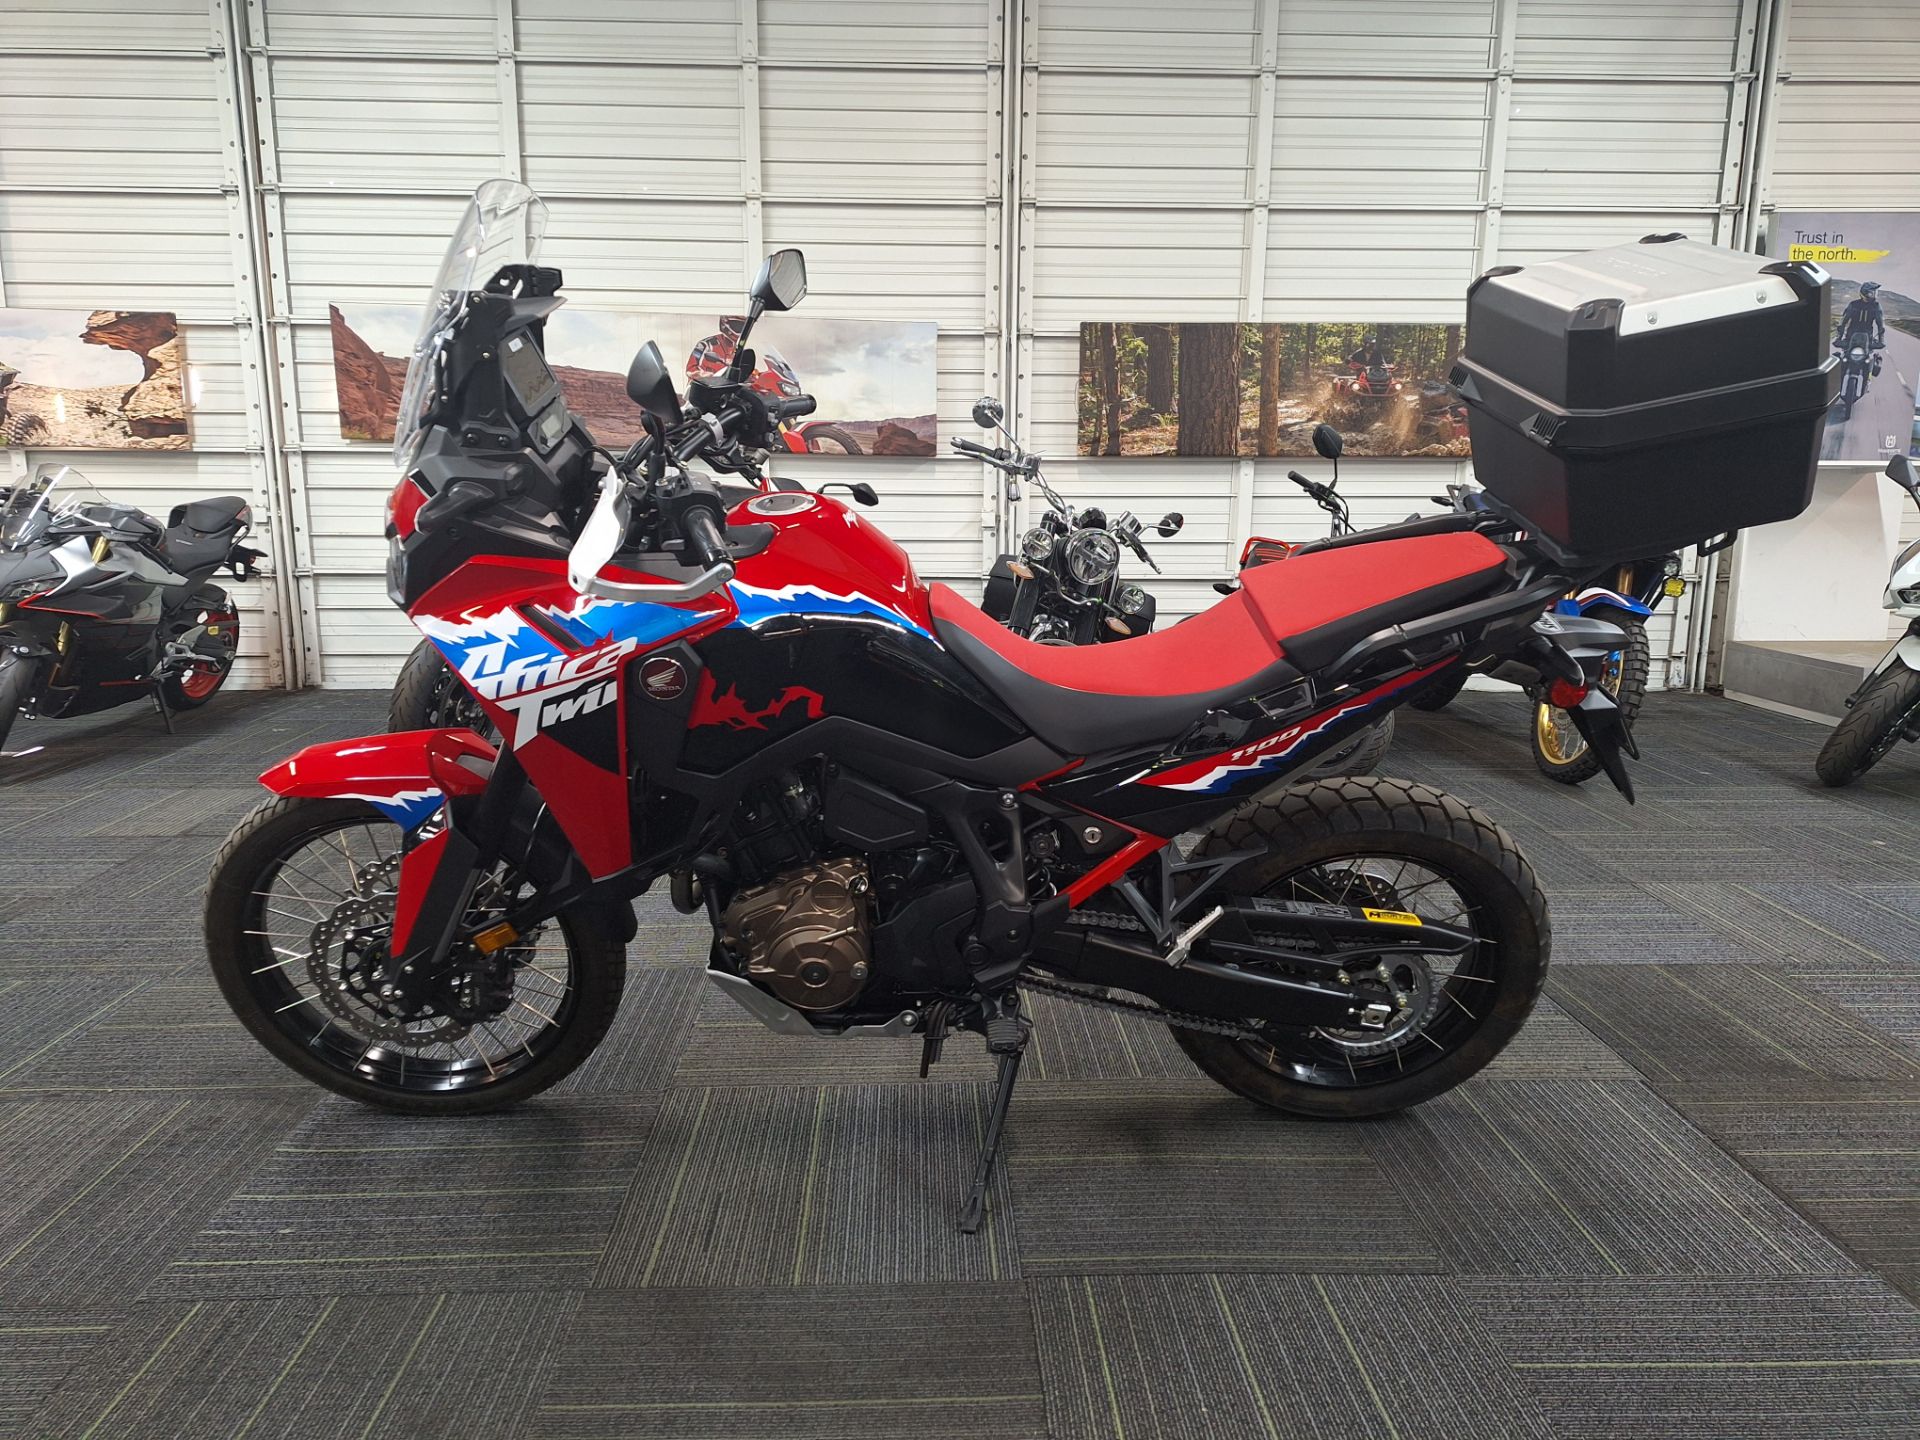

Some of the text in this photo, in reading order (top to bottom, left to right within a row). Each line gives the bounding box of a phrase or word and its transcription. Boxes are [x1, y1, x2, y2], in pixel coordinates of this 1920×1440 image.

[1794, 230, 1844, 244] Trust in
[1792, 247, 1857, 260] the north.
[458, 636, 639, 700] Africa
[1230, 726, 1302, 762] 1100
